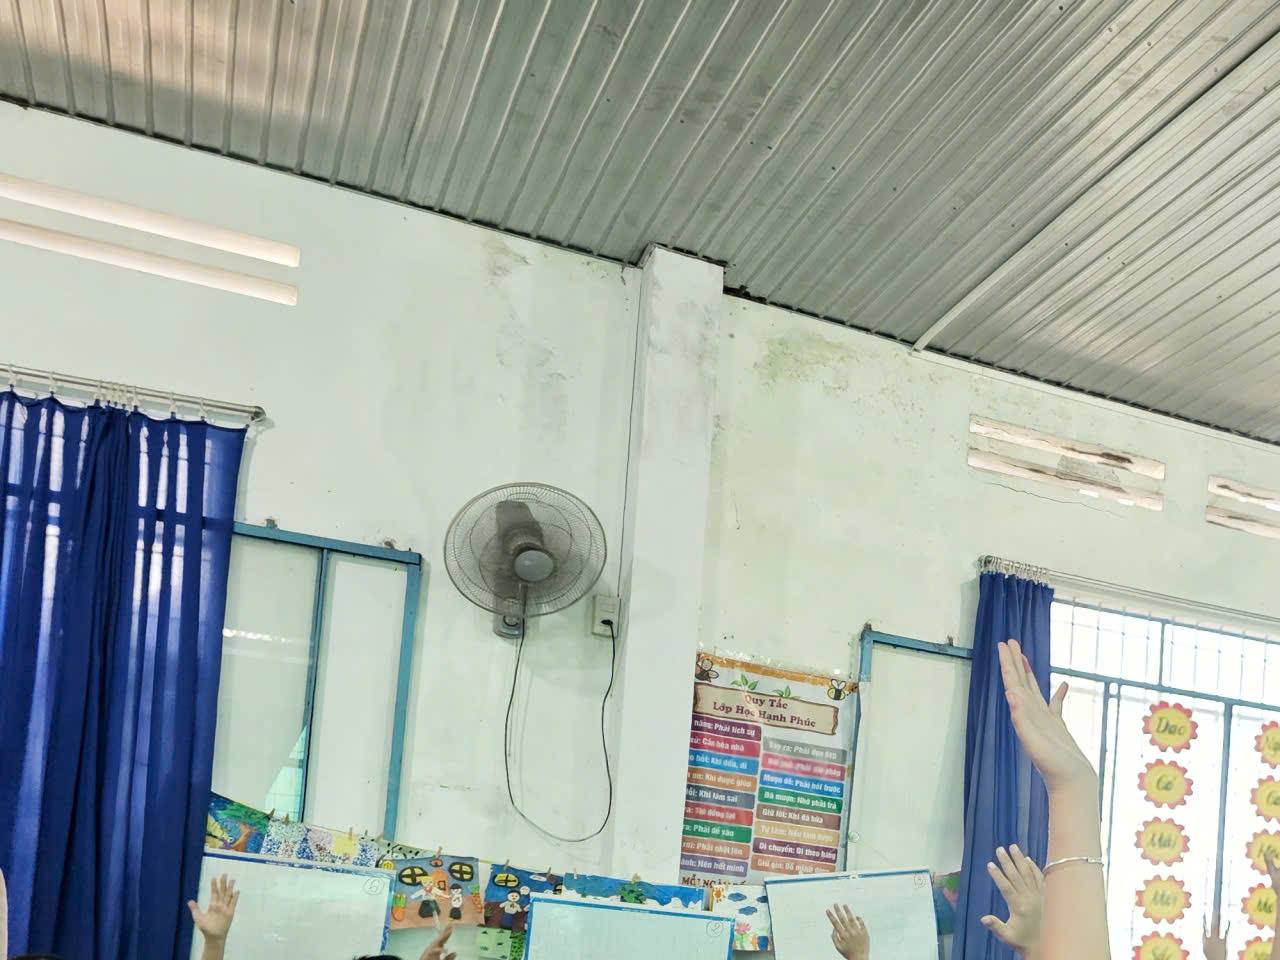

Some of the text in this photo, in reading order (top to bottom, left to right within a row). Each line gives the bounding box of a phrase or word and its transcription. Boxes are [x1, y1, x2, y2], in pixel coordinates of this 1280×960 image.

[744, 694, 765, 706] Quy
[713, 701, 733, 713] Lớp
[758, 710, 787, 723] Hạnh
[791, 716, 817, 727] Phúc
